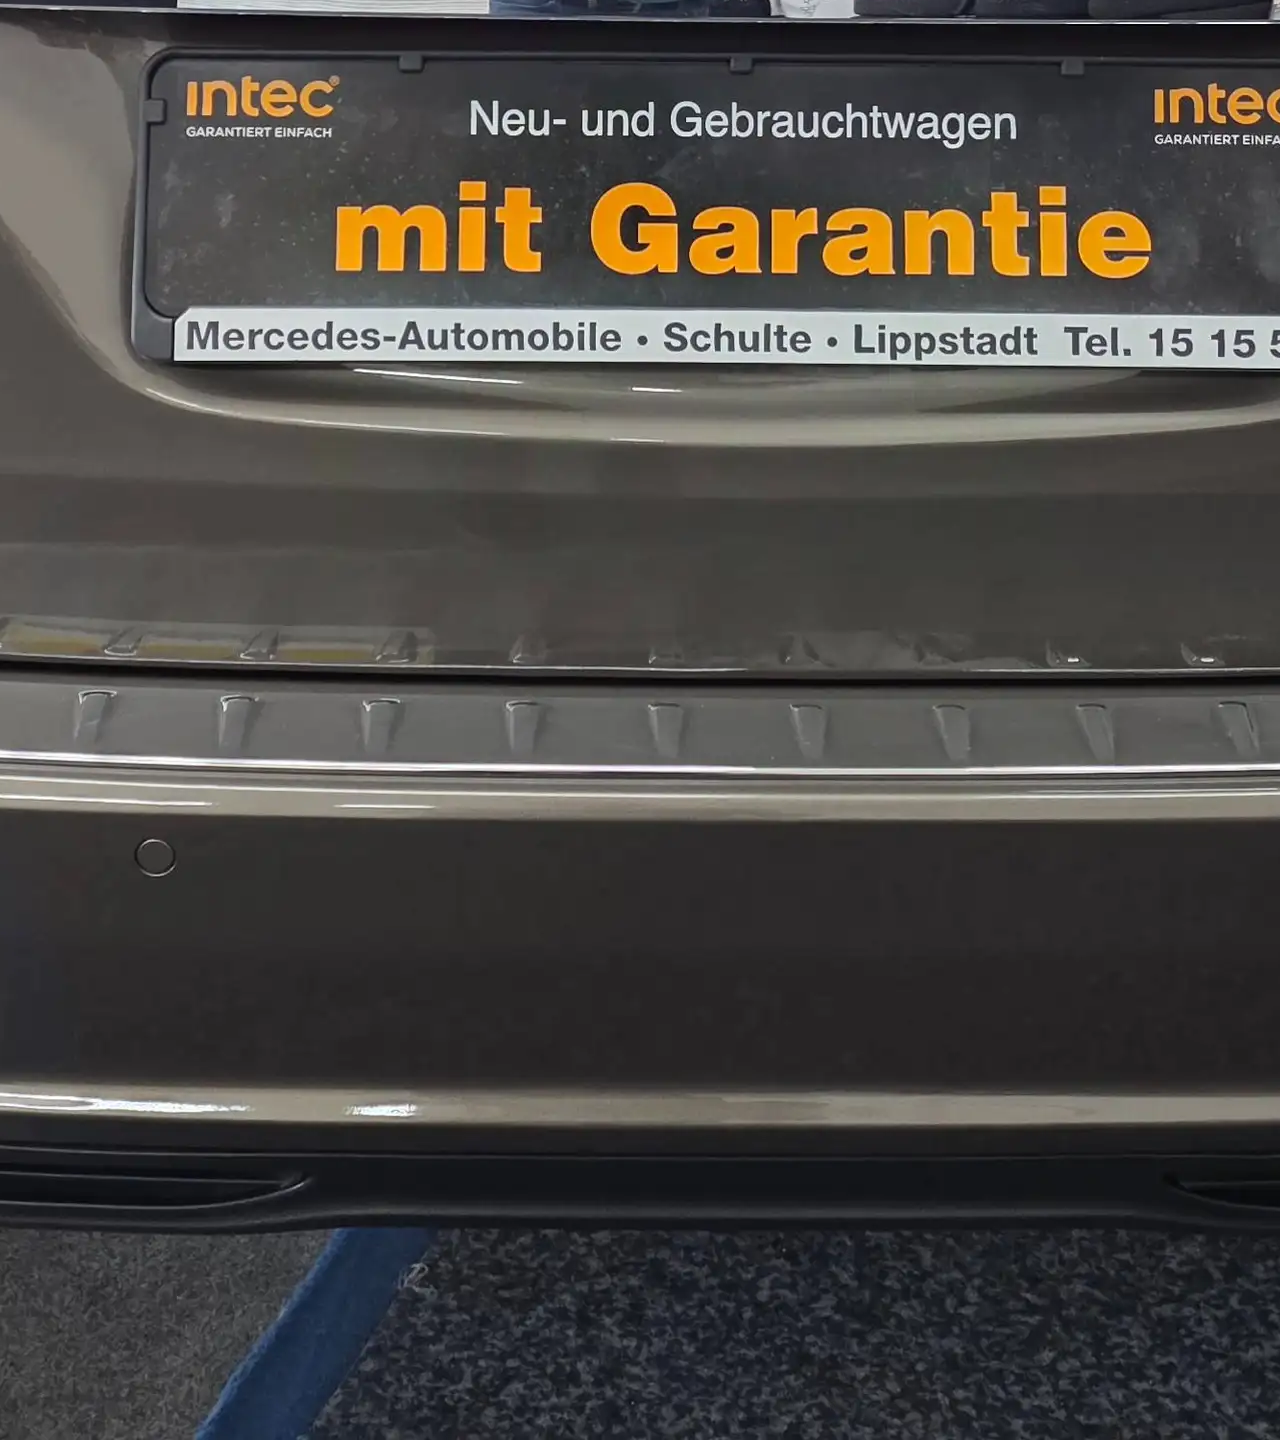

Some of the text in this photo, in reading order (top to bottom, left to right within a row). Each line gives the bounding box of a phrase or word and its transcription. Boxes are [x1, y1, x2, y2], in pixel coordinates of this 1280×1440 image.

[185, 125, 333, 139] GARANTIERT EINFACH
[469, 99, 1018, 150] Neu- und Gebrauchtwagen
[1154, 133, 1240, 147] GARANTIERT
[335, 179, 1153, 280] mit Garantie
[185, 320, 623, 353] Mercedes-Automobile
[662, 321, 813, 355] Schulte
[853, 323, 1039, 362] Lippstadt
[1062, 325, 1133, 358] Tel.
[1147, 327, 1195, 358] 15
[1209, 328, 1257, 360] 15
